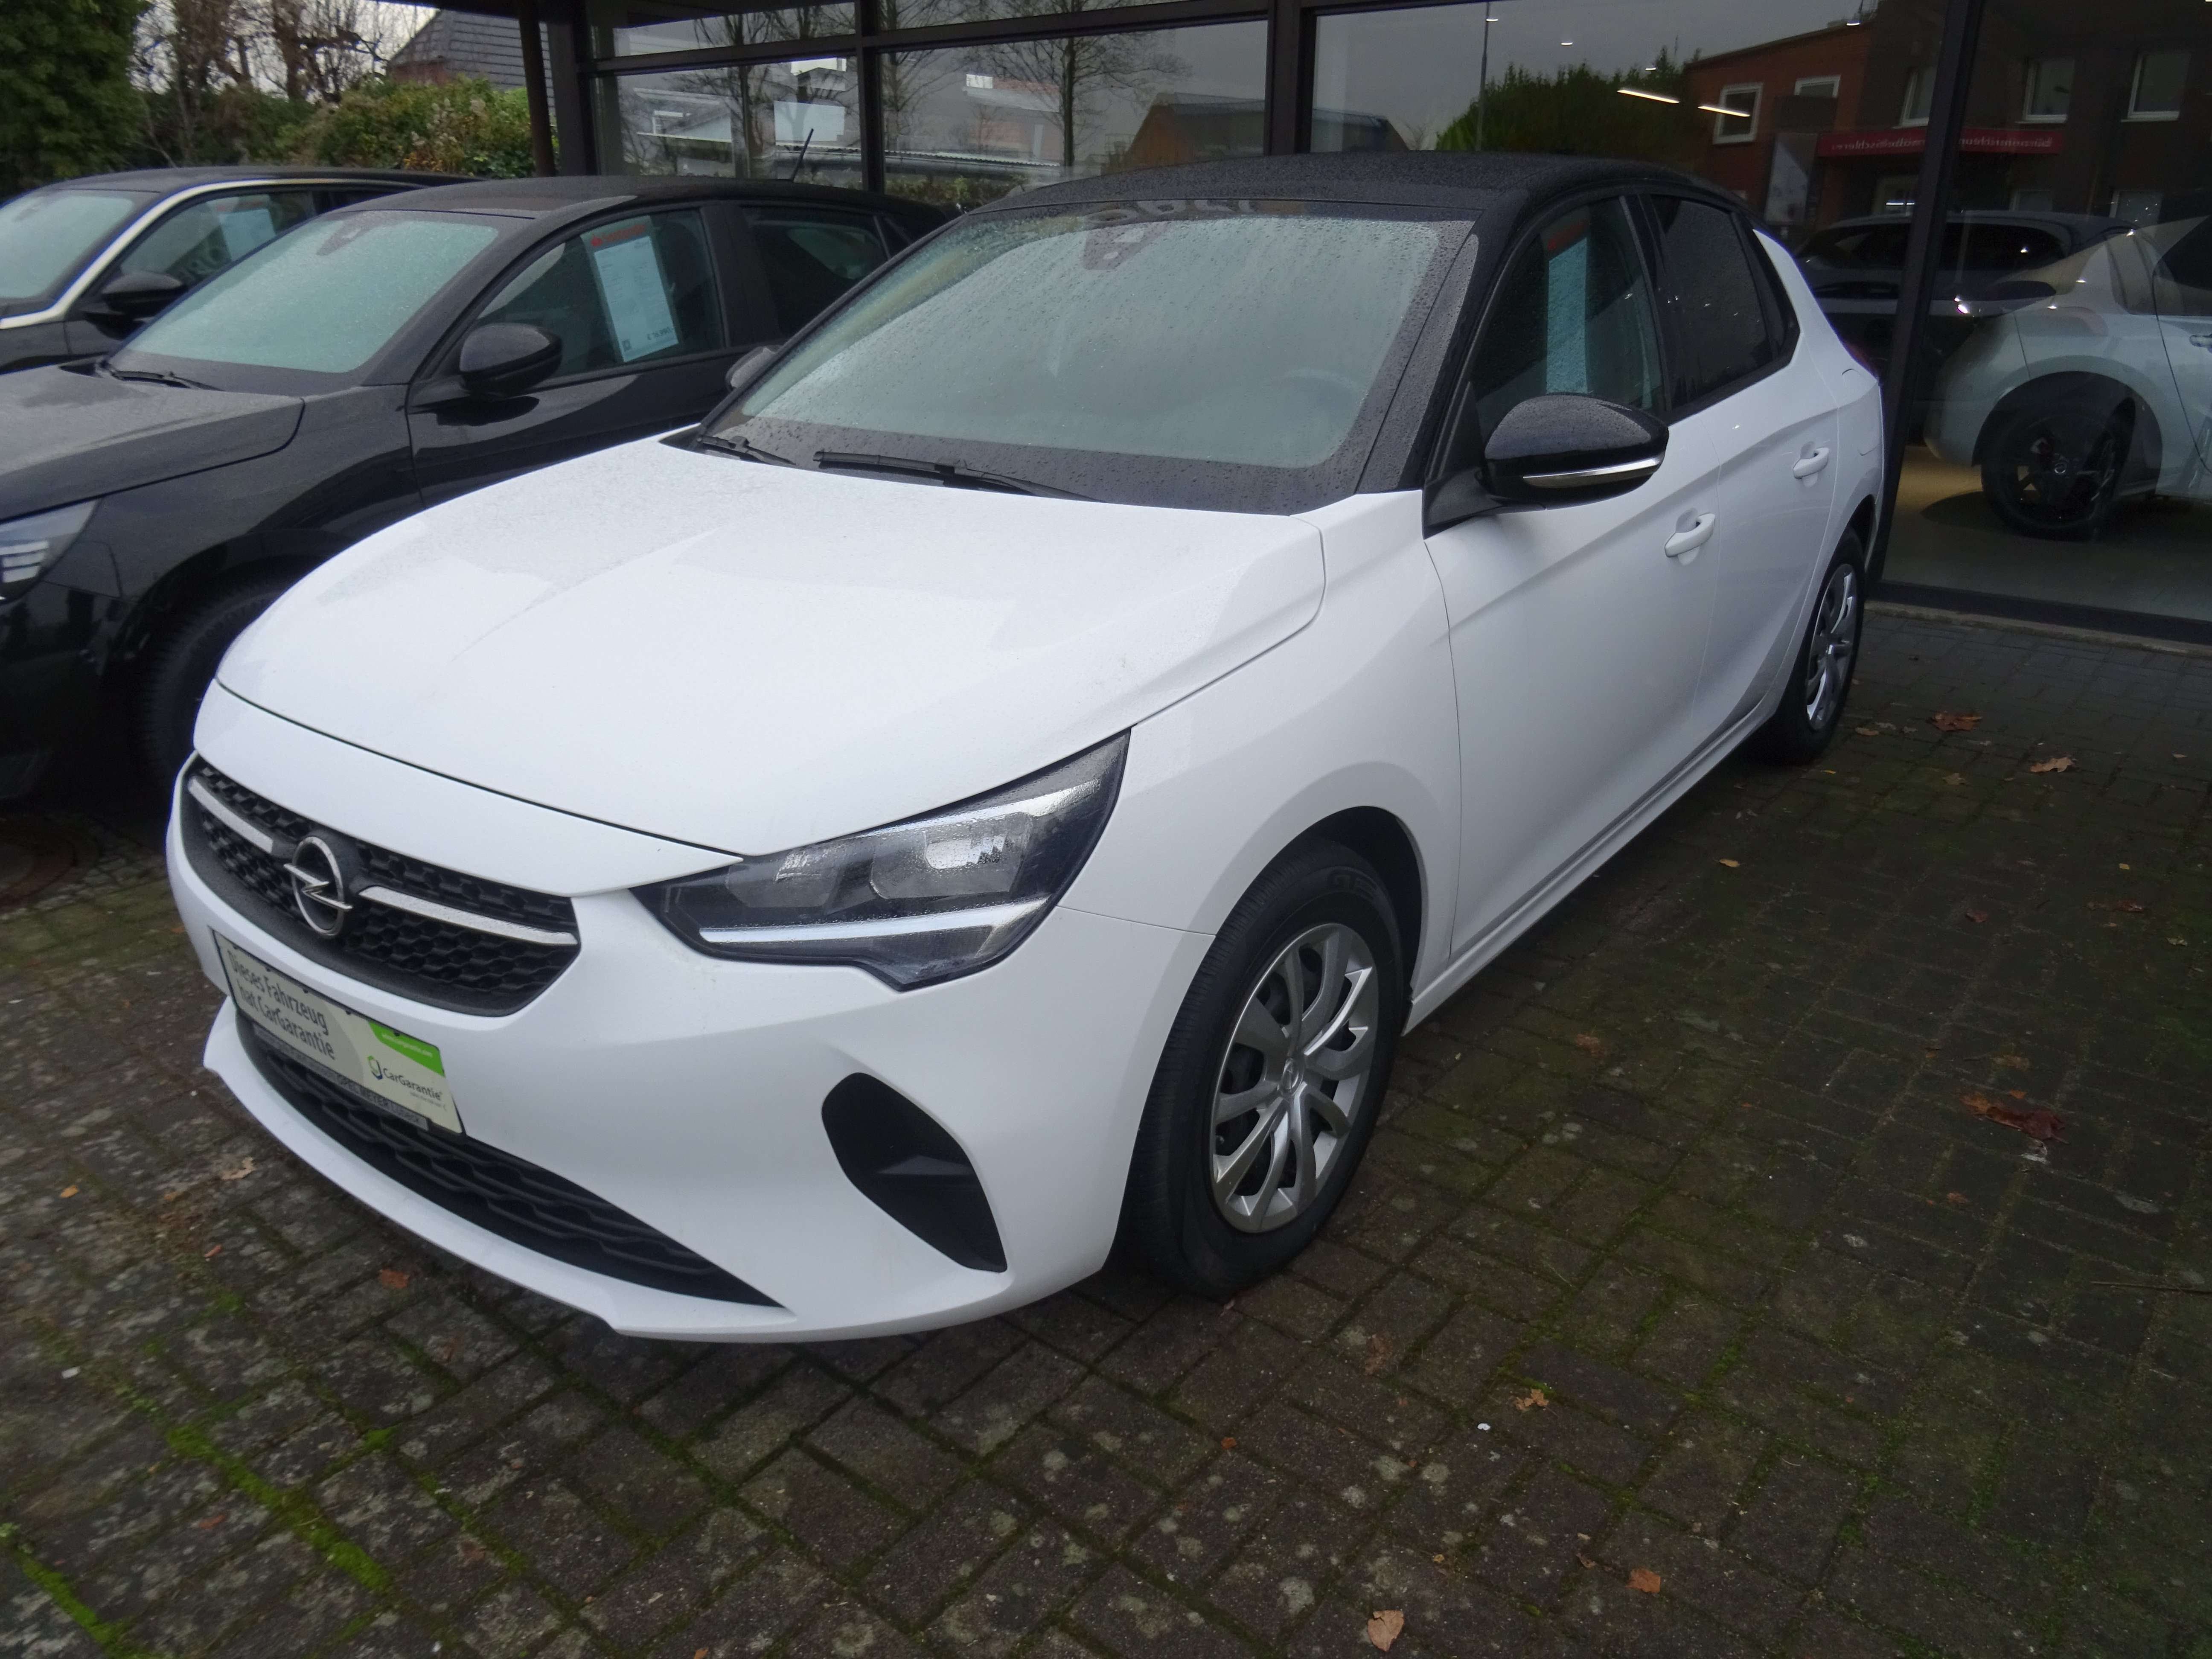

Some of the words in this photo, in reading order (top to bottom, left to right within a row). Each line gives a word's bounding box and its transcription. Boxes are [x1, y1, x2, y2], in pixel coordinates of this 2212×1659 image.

[227, 949, 265, 993] Dieses
[263, 975, 329, 1036] Fahrzeug
[237, 978, 259, 1011] hat
[257, 995, 335, 1061] CarGarantie
[383, 1068, 441, 1101] CarGarantie
